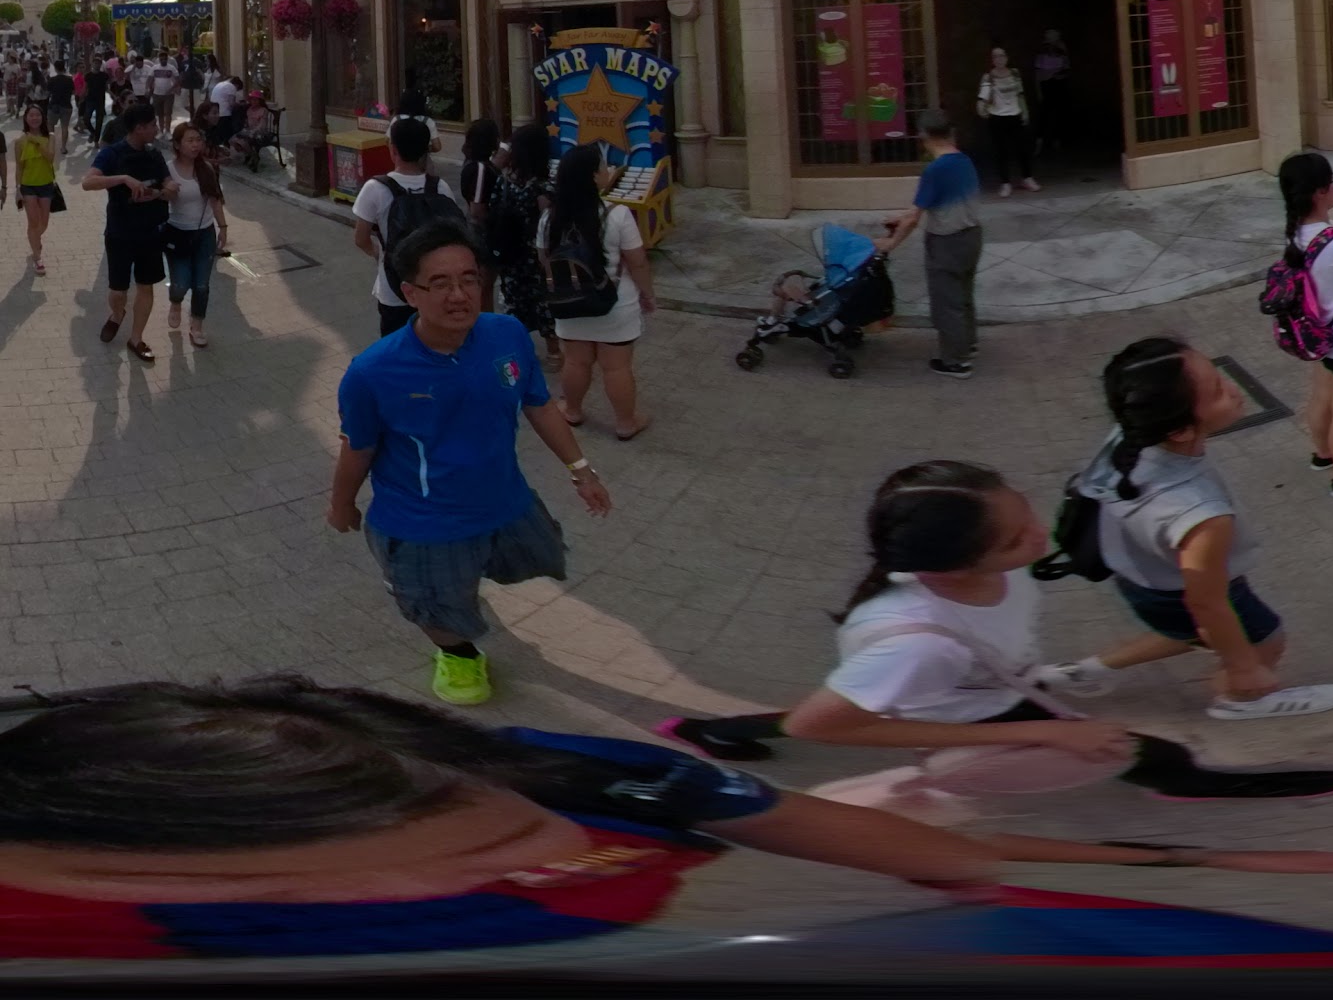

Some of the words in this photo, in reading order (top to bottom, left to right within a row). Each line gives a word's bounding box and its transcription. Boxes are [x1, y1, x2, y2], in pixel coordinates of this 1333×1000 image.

[584, 31, 599, 39] Far
[601, 30, 627, 41] Away
[533, 47, 589, 88] STAR
[605, 47, 672, 91] MAPS
[581, 100, 620, 114] TOURS
[585, 115, 616, 129] HERE
